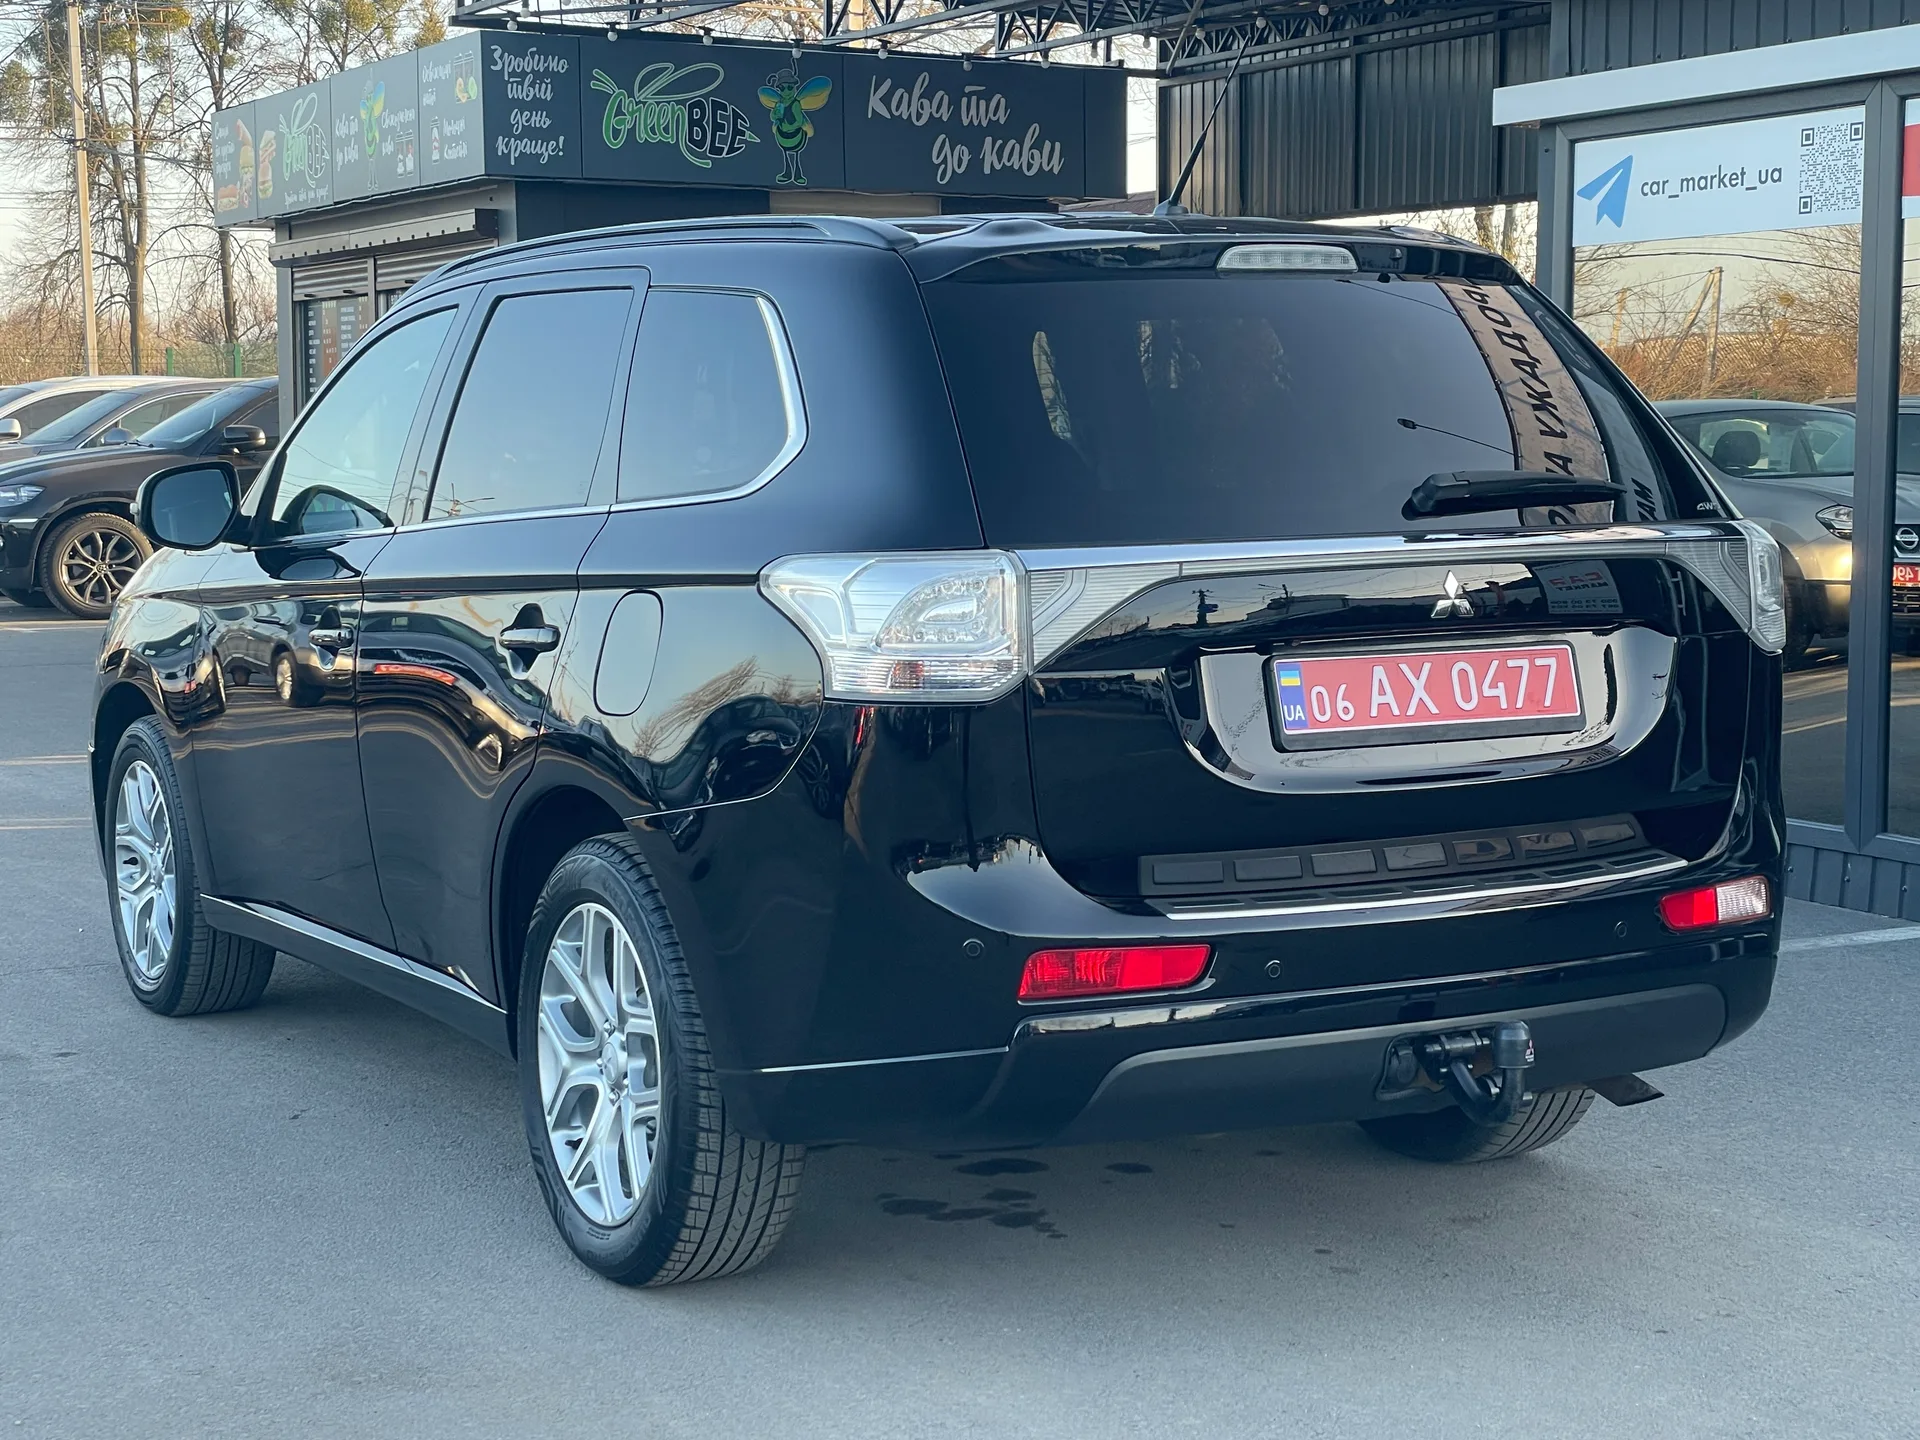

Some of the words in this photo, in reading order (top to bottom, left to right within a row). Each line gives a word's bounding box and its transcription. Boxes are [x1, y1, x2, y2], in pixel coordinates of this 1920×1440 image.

[490, 45, 569, 80] Зробимо
[507, 73, 553, 101] твій
[868, 71, 953, 126] Кава
[961, 85, 1010, 127] та
[510, 108, 552, 135] день
[496, 135, 565, 165] краще!
[932, 133, 971, 184] до
[980, 123, 1064, 176] кави
[1640, 164, 1783, 199] car_market_ua
[1310, 683, 1355, 723] 06
[1369, 662, 1440, 718] AX
[1451, 656, 1557, 712] 0477
[1283, 704, 1306, 722] UA
